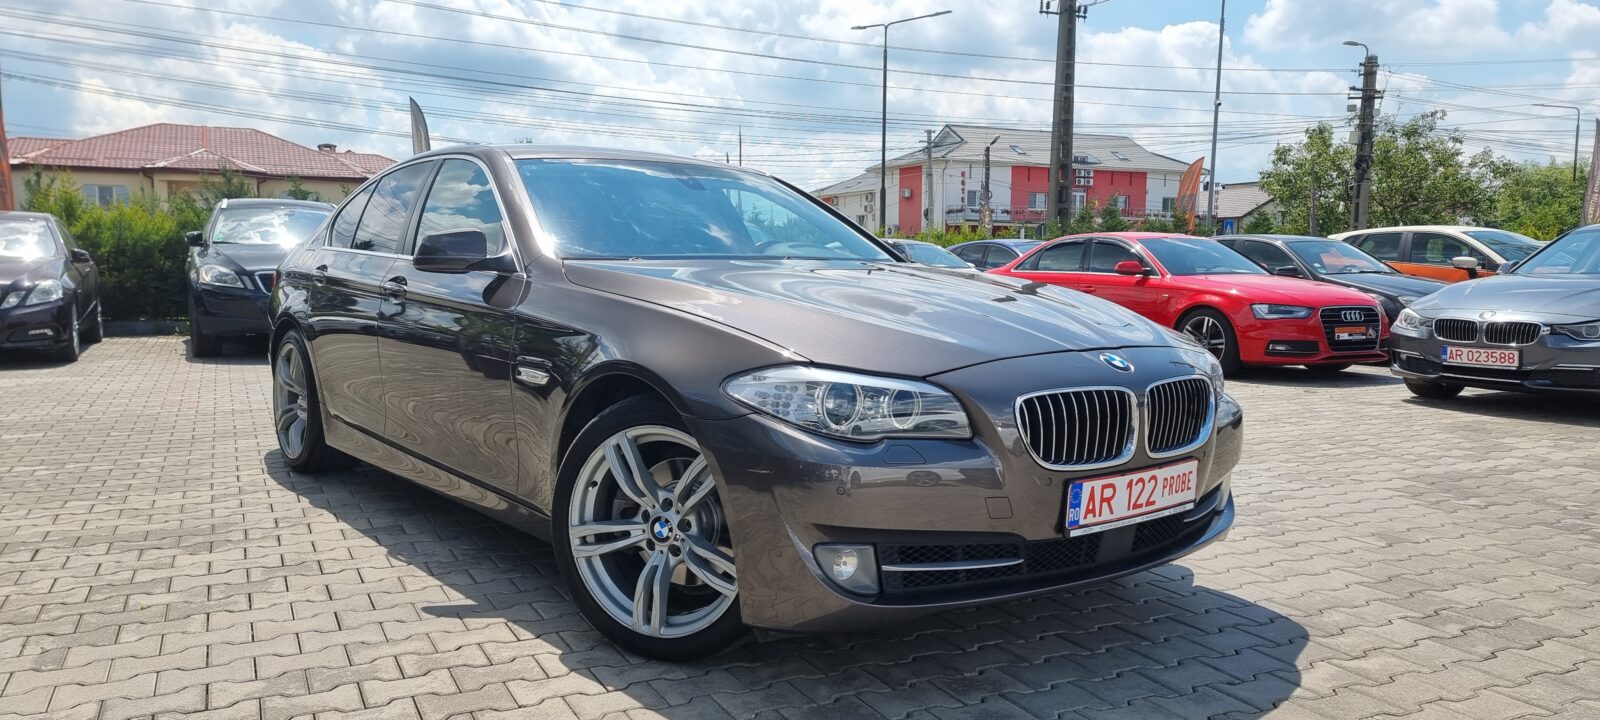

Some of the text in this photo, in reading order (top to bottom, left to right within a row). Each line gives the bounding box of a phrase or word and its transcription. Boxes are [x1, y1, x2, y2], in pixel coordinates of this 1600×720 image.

[1449, 348, 1463, 361] AR
[1466, 350, 1516, 364] 023588
[1083, 471, 1193, 520] AR 122 PROBE
[1069, 508, 1079, 521] RO
